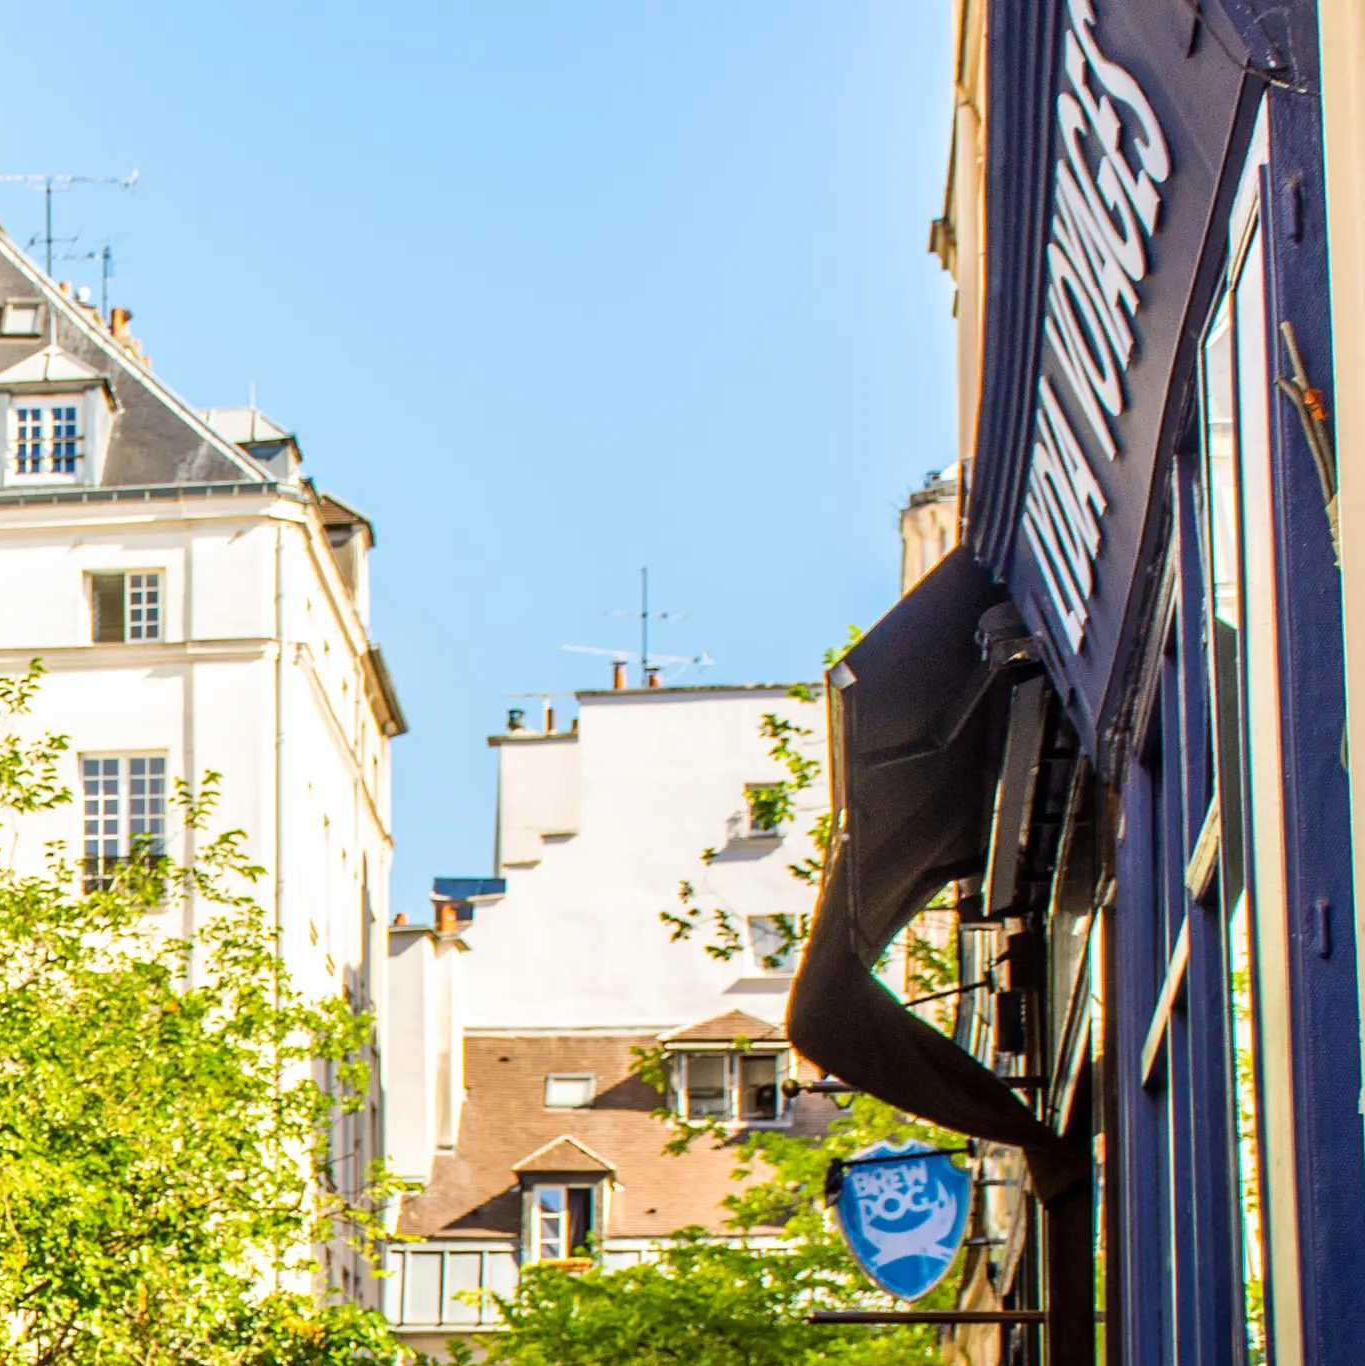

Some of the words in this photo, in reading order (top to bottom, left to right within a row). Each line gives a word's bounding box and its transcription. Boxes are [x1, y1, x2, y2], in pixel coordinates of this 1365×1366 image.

[1045, 0, 1169, 461] VOYAGES
[1022, 376, 1106, 655] LYDIA
[853, 1161, 929, 1198] BREW
[859, 1186, 931, 1222] DOG
